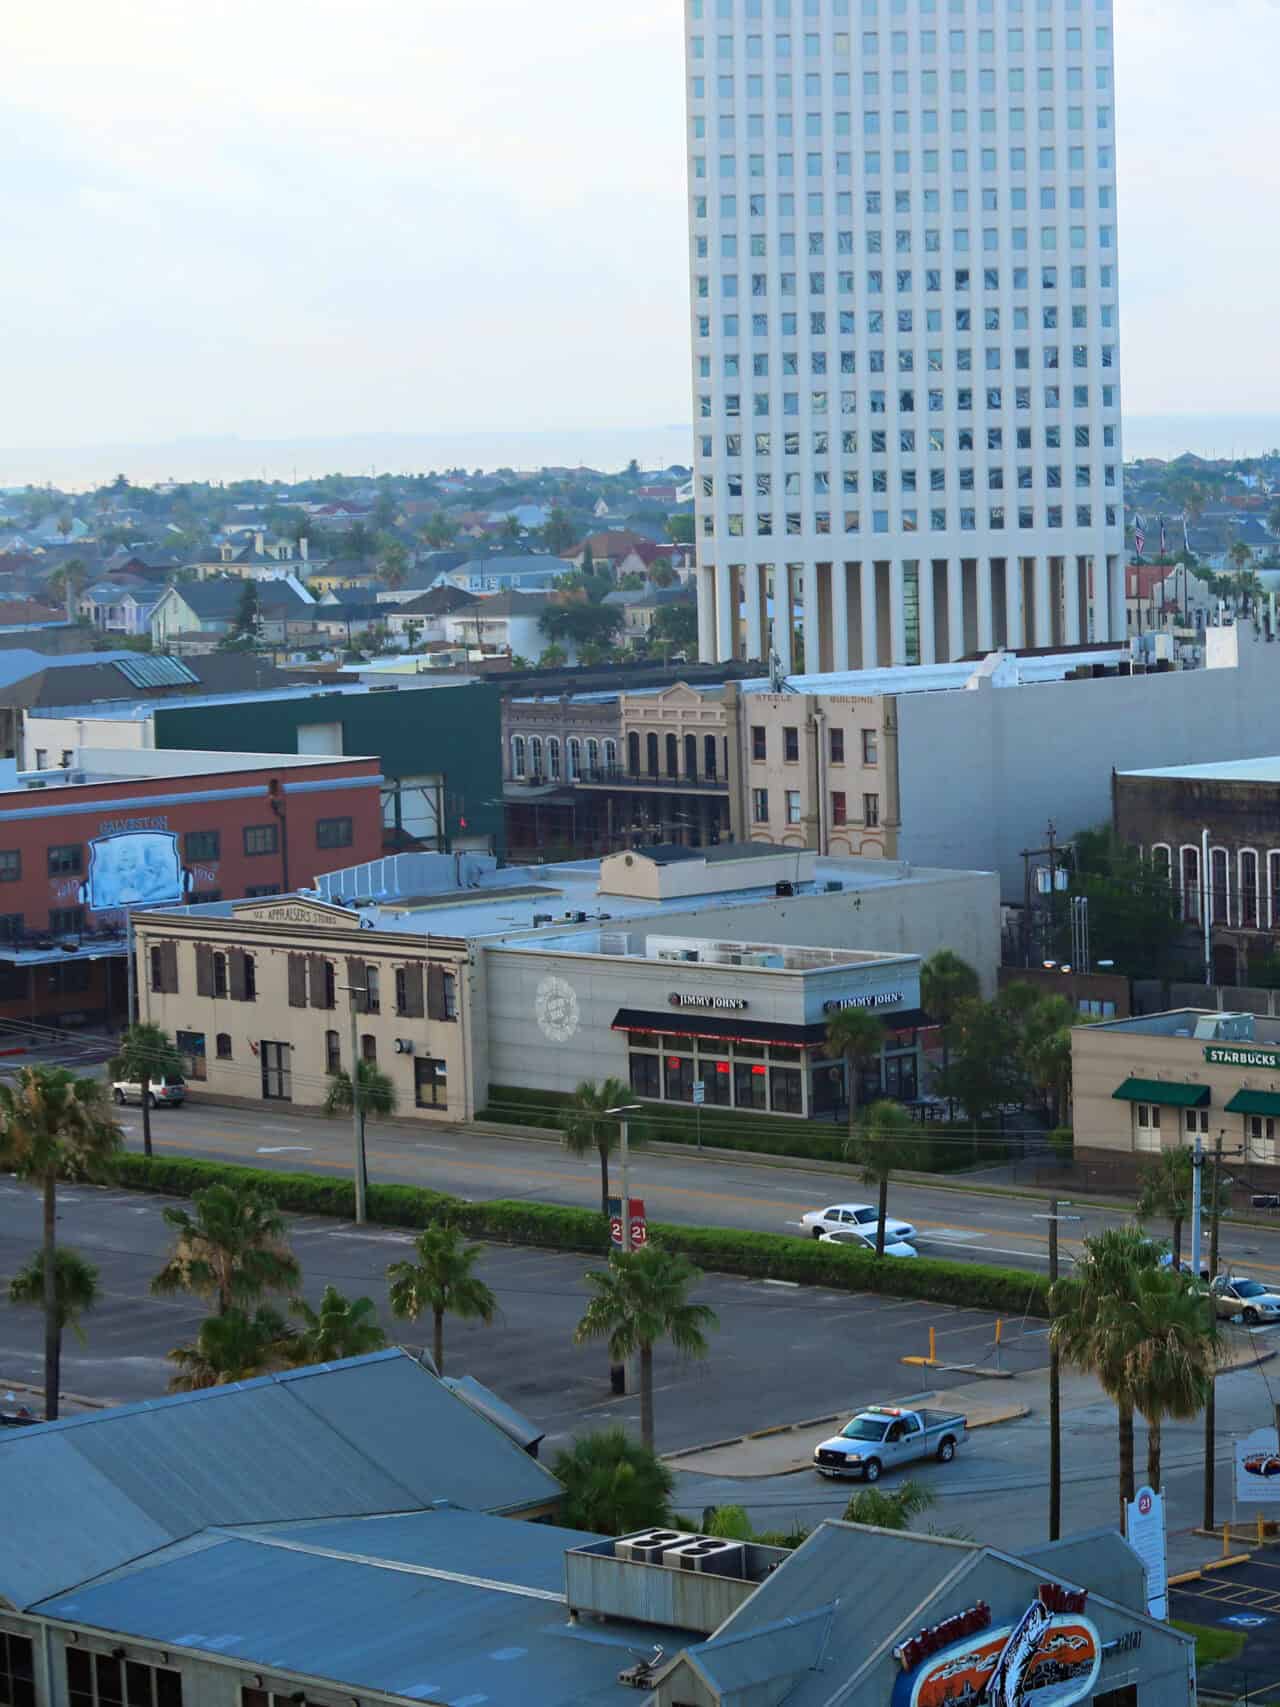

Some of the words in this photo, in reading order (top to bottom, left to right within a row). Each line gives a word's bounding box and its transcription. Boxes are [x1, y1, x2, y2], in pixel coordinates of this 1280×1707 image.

[680, 993, 710, 1008] JIMMY
[712, 996, 744, 1009] JOHN'S
[840, 995, 872, 1010] JIMMY
[874, 990, 905, 1008] JOHN'S
[1210, 1050, 1275, 1065] STARBUCKS
[631, 1226, 646, 1240] 21
[1140, 1498, 1150, 1511] 21
